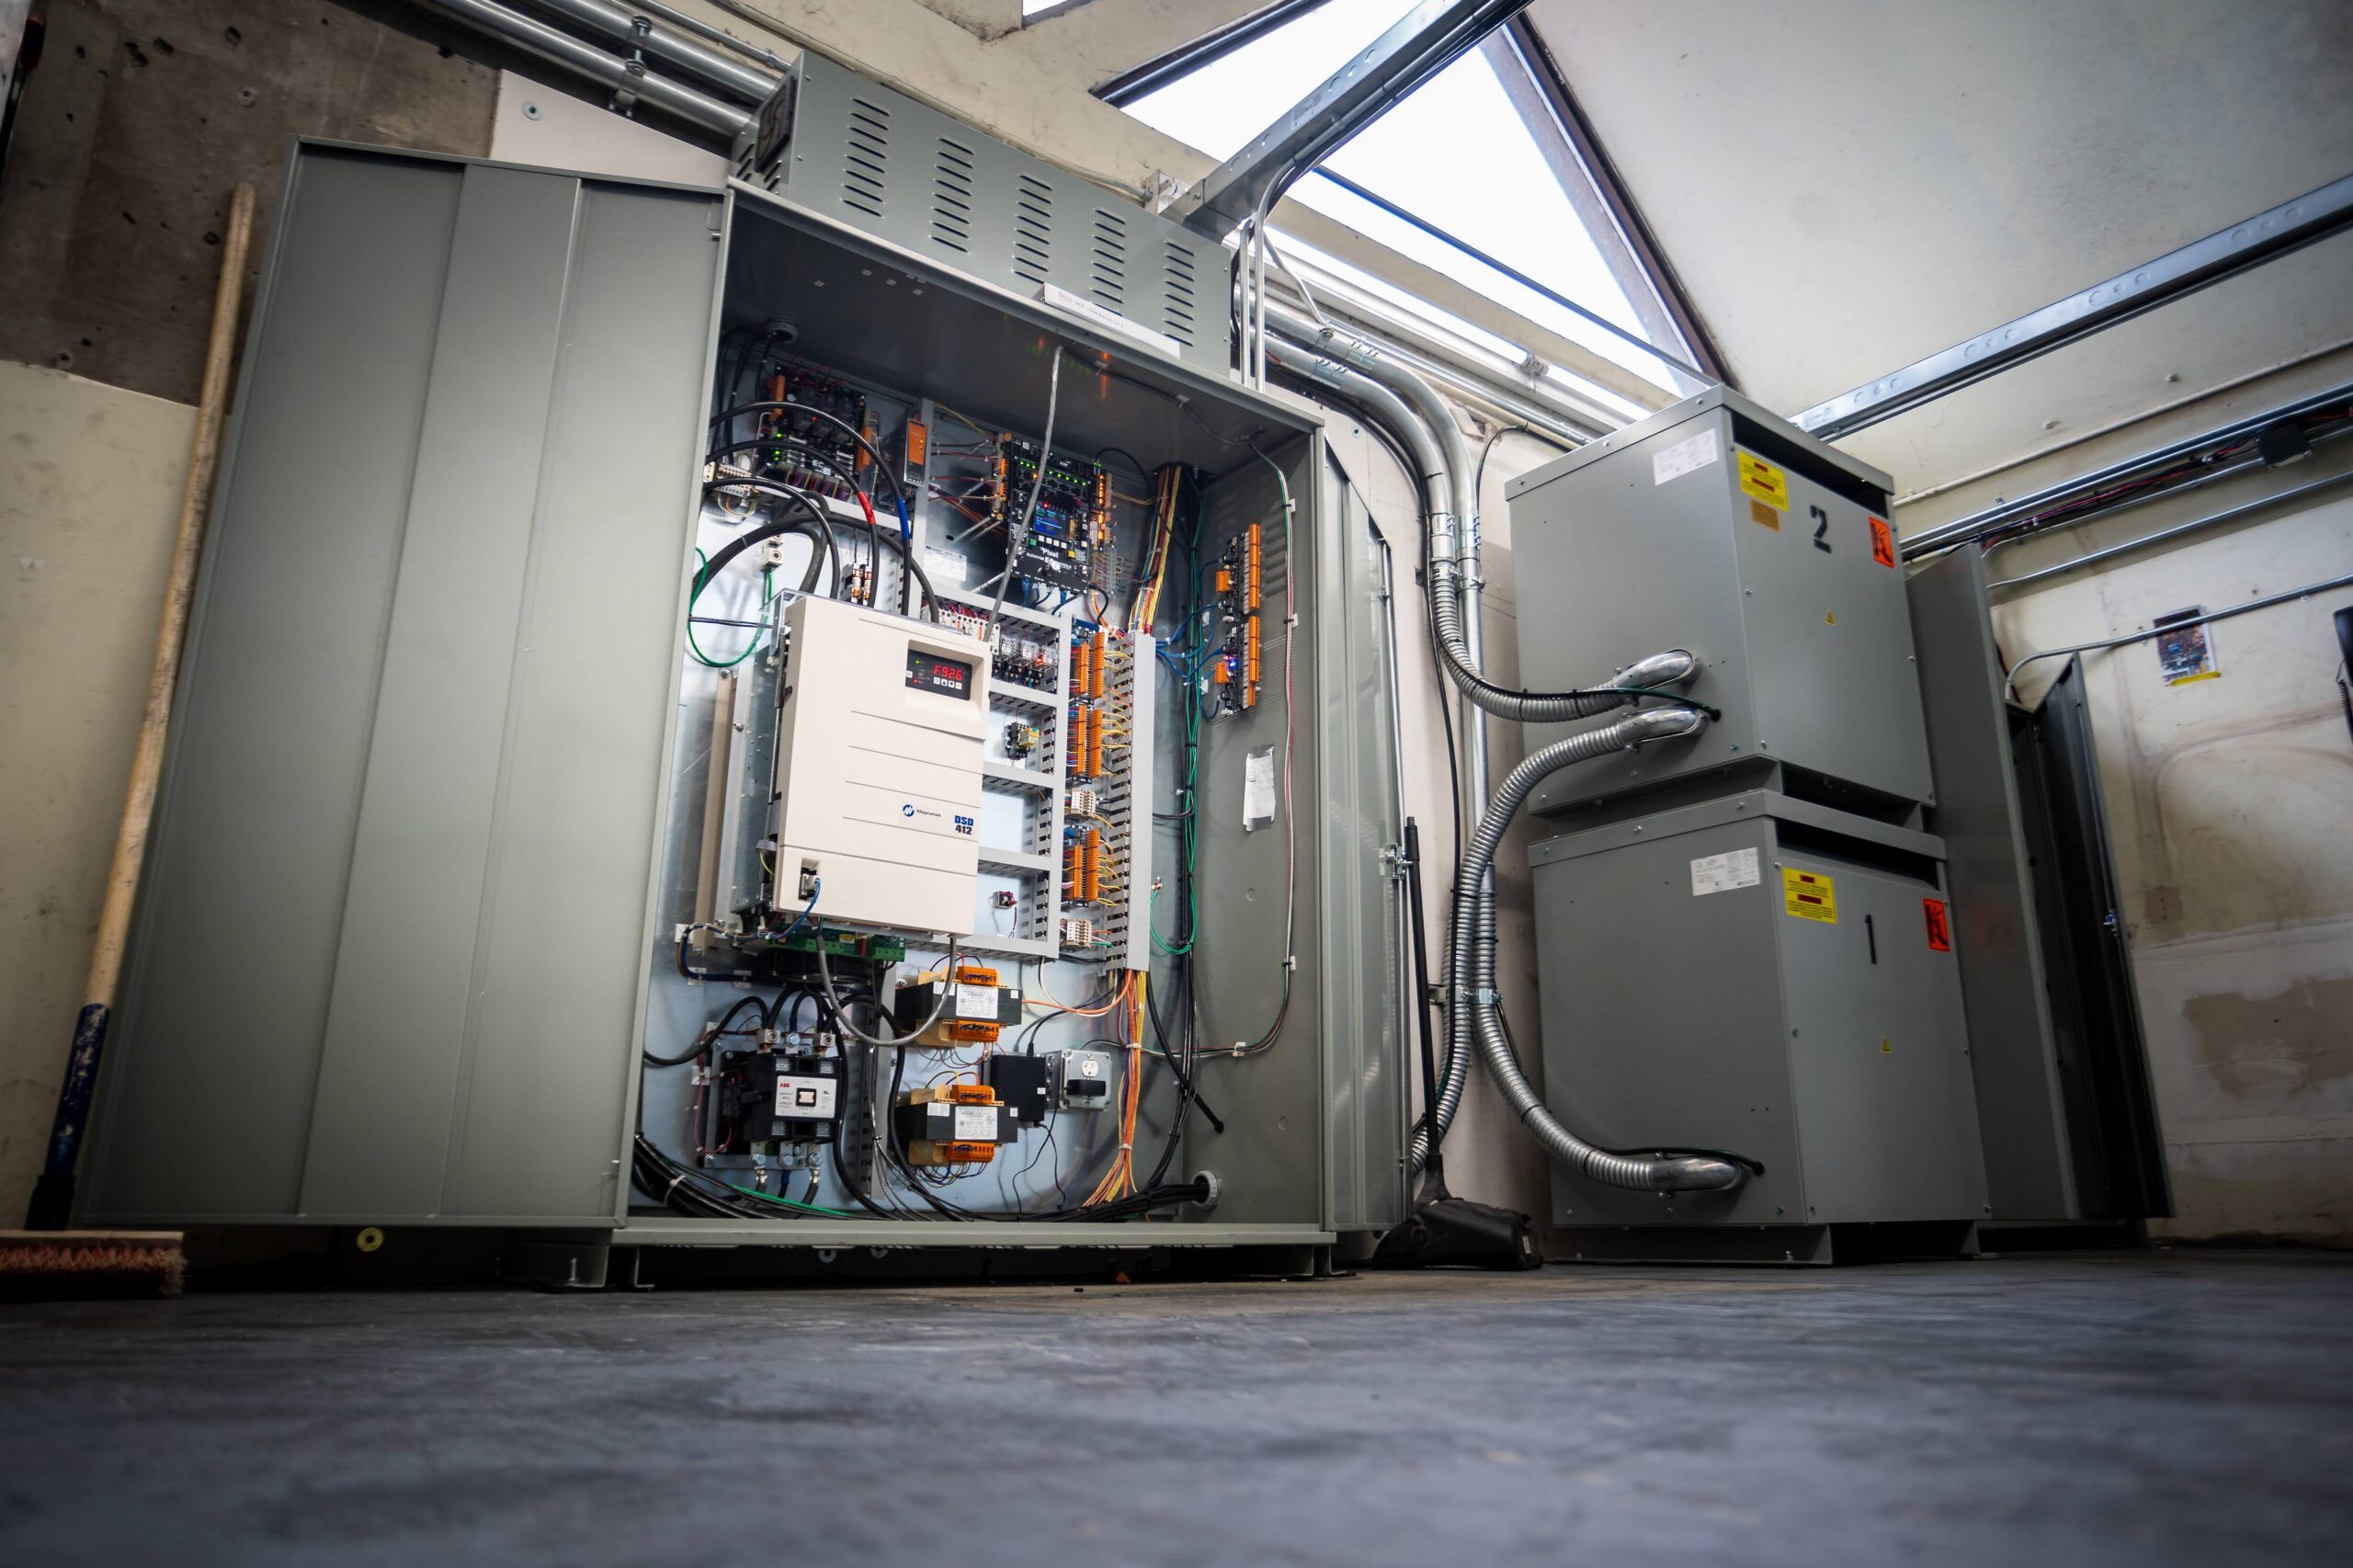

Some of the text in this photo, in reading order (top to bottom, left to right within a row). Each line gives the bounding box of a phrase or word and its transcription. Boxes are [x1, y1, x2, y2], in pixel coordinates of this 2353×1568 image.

[1810, 505, 1832, 554] 2
[933, 664, 963, 680] F926
[916, 809, 941, 818] Magnetek
[955, 824, 972, 835] 412
[1864, 915, 1877, 965] 1
